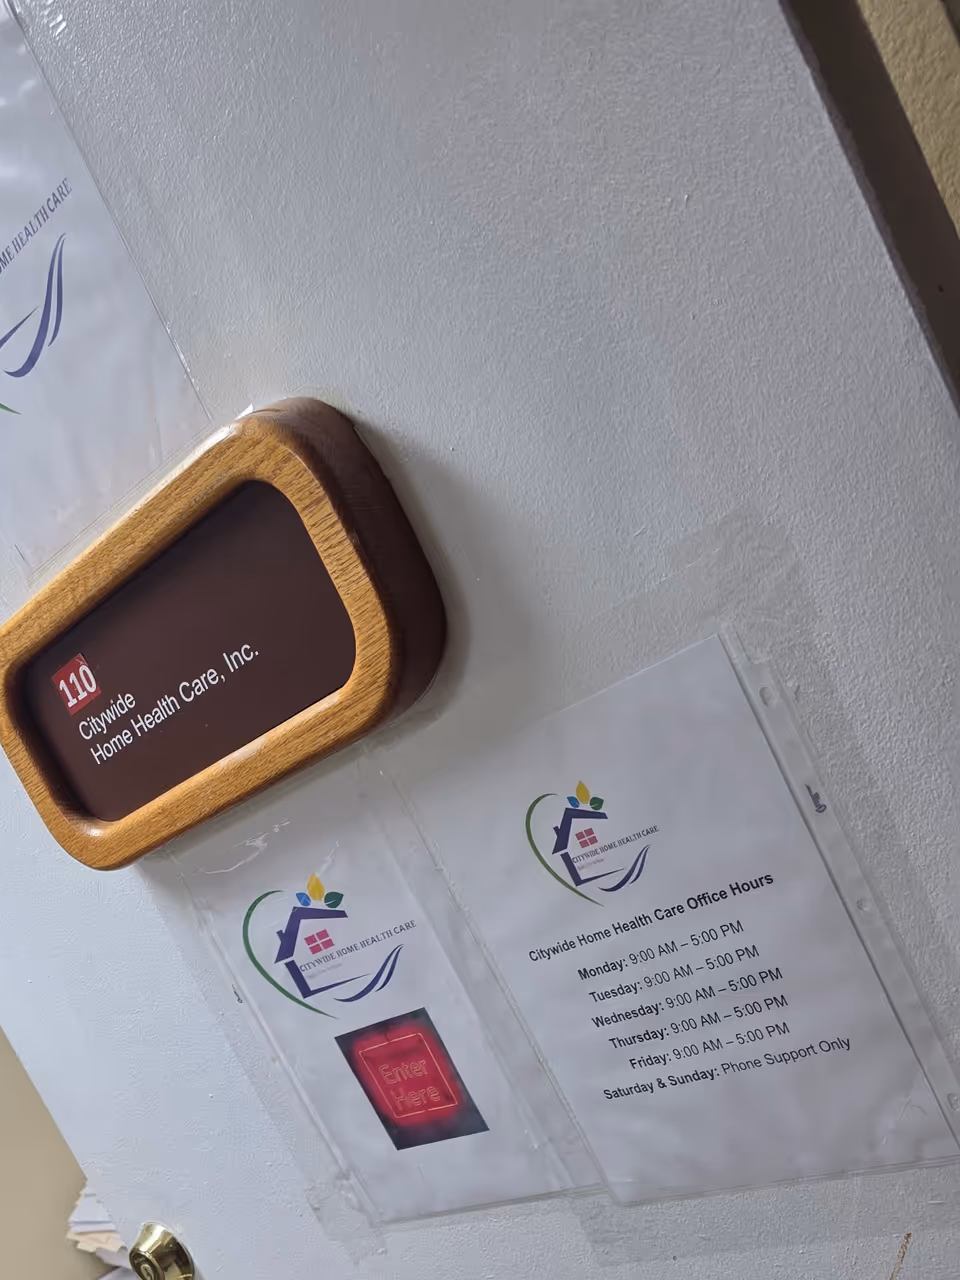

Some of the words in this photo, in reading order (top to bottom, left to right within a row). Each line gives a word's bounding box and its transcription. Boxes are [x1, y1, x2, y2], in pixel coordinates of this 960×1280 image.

[11, 206, 50, 255] HEALTH
[45, 177, 72, 214] CARE
[59, 664, 97, 708] 110
[90, 729, 134, 765] Home
[131, 694, 181, 737] Health
[178, 668, 226, 703] Care,
[223, 644, 259, 673] Inc.
[78, 692, 136, 740] Citywide
[572, 850, 600, 864] CITYWIDE
[600, 841, 618, 854] HOME
[618, 832, 642, 847] HEALTH
[642, 825, 659, 837] CARE
[299, 952, 338, 972] CITYWIDE
[336, 943, 361, 959] HOME
[359, 929, 394, 949] HEALTH
[393, 919, 417, 935] CARE
[529, 939, 577, 963] Citywide
[576, 929, 612, 947] Home
[612, 914, 653, 935] Health
[653, 904, 685, 922] Care
[687, 888, 729, 910] Office
[729, 874, 774, 896] Hours
[577, 957, 629, 981] Monday:
[629, 947, 656, 965] 9:00
[657, 940, 679, 957] AM
[690, 928, 719, 947] 5:00
[720, 920, 745, 937] PM
[589, 979, 643, 1003] Tuesday:
[643, 970, 671, 988] 9:00
[673, 963, 694, 980] AM
[705, 952, 734, 971] 5:00
[735, 944, 760, 962] PM
[591, 1001, 665, 1028] Wednesday:
[665, 991, 693, 1009] 9:00
[695, 985, 716, 1002] AM
[728, 975, 758, 992] 5:00
[758, 967, 783, 985] PM
[609, 1026, 670, 1049] Thursday:
[670, 1018, 698, 1035] 9:00
[700, 1011, 722, 1028] AM
[733, 1001, 763, 1018] 5:00
[763, 994, 789, 1011] PM
[378, 1059, 428, 1085] Enter
[603, 1077, 655, 1100] Saturday
[657, 1076, 668, 1089] &
[667, 1066, 720, 1087] Sunday:
[721, 1058, 763, 1076] Phone
[763, 1044, 818, 1066] Support
[818, 1036, 851, 1053] Only
[629, 1052, 672, 1077] Friday:
[672, 1044, 700, 1061] 9:00
[702, 1038, 724, 1054] AM
[735, 1028, 764, 1045] 5:00
[765, 1021, 791, 1038] PM
[390, 1086, 441, 1111] Here
